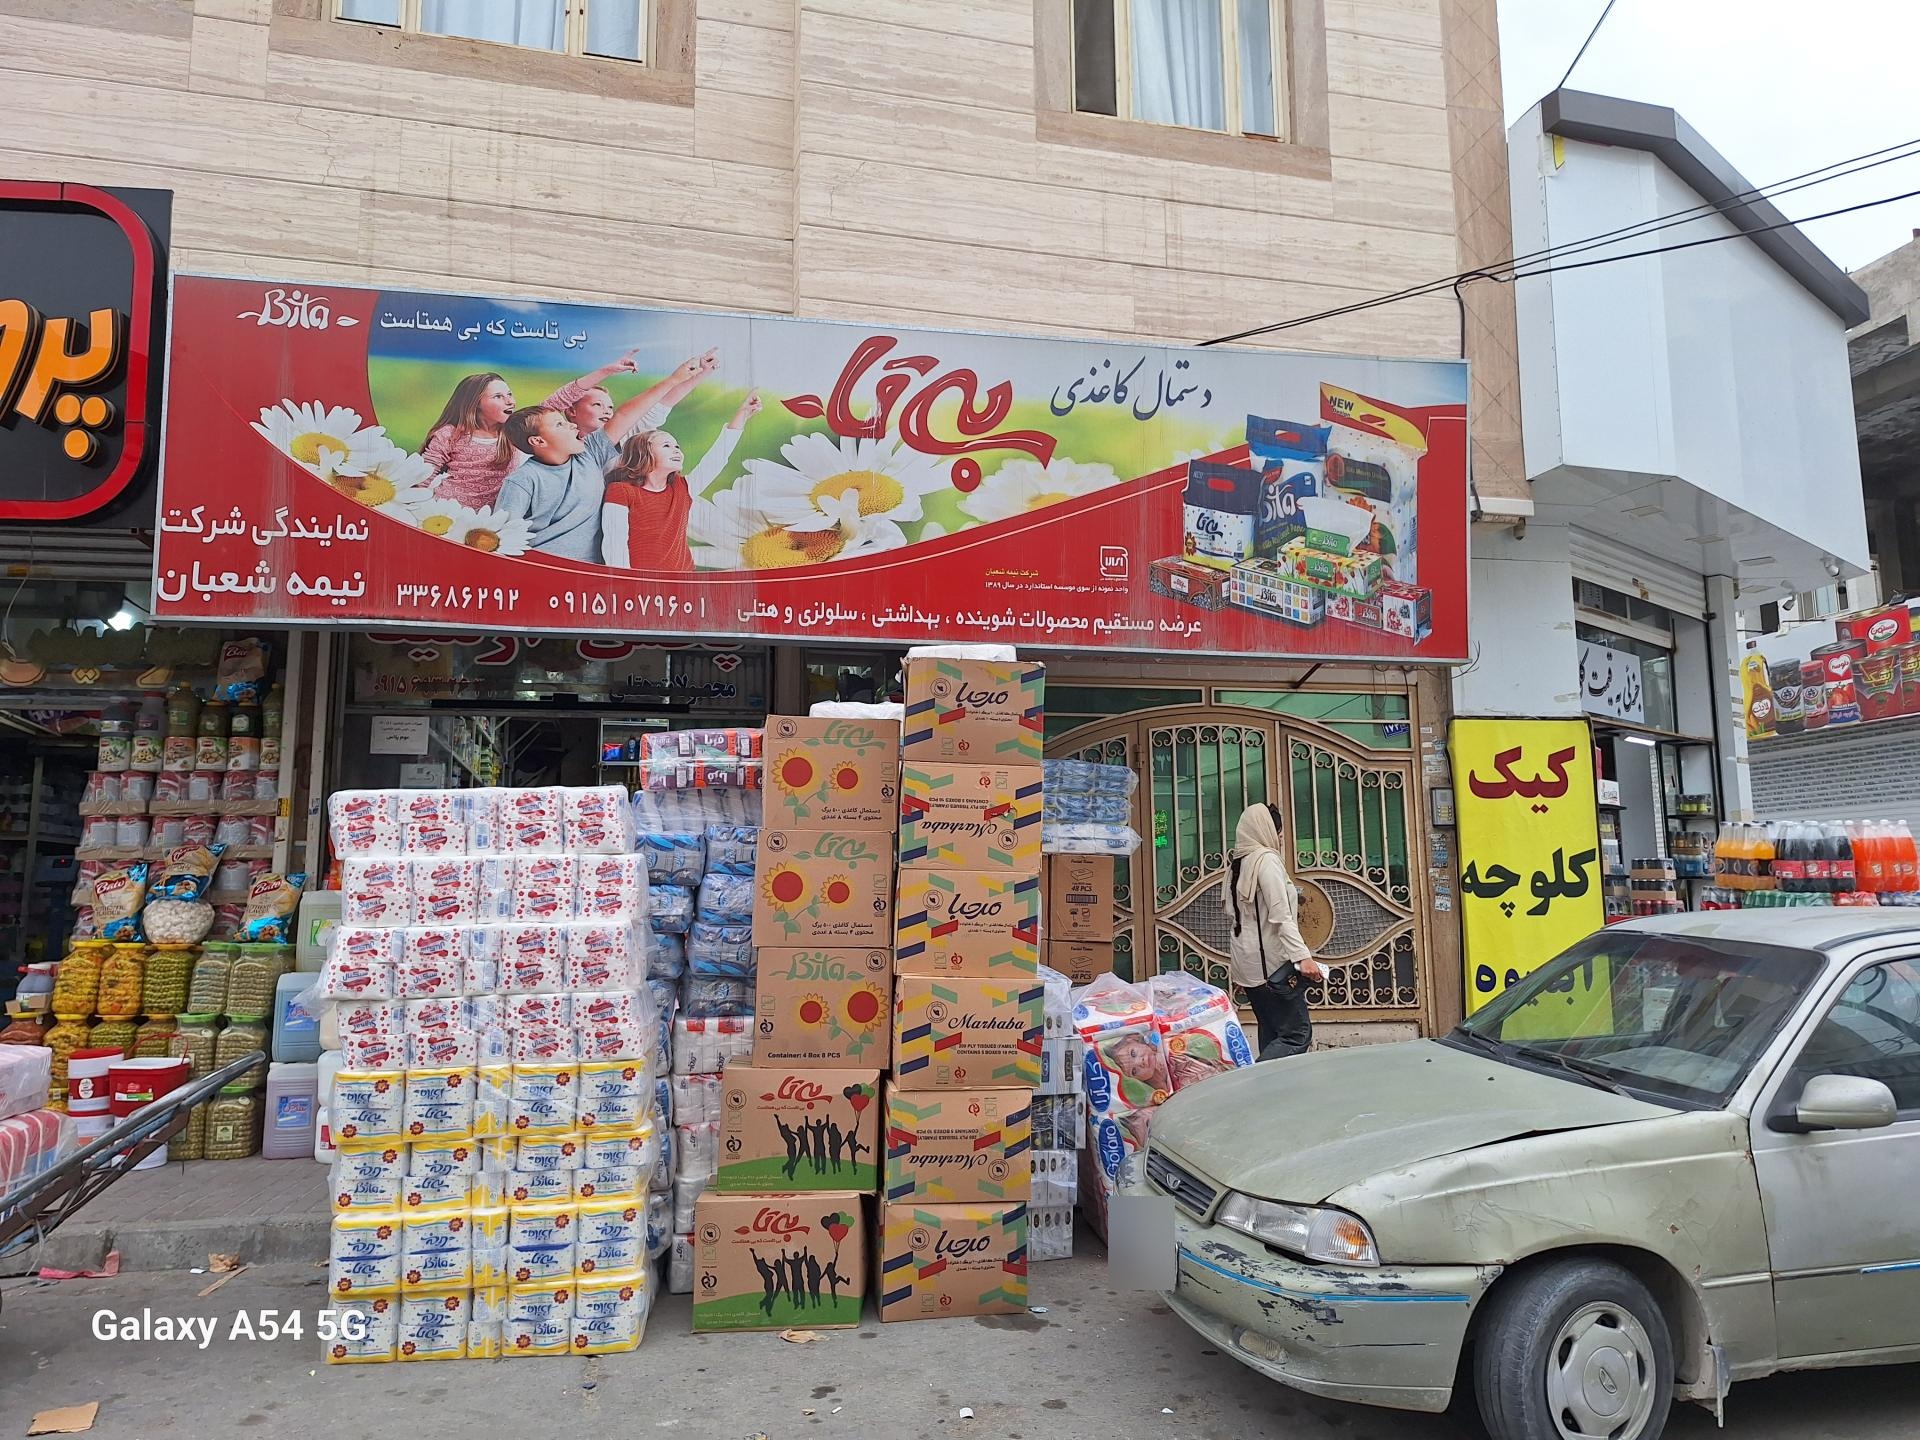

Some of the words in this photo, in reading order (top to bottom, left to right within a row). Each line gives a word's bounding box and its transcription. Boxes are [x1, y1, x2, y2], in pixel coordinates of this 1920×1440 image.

[255, 288, 331, 330] Bita
[379, 309, 453, 333] همتاست
[457, 320, 481, 341] بی
[485, 317, 506, 337] که
[510, 319, 560, 340] تاست
[563, 327, 588, 349] بی
[1050, 355, 1147, 417] کاغذی
[1132, 360, 1213, 422] دستمال
[1329, 394, 1354, 413] NEW
[160, 504, 247, 544] شرکت
[251, 505, 370, 547] نمایندگی
[156, 559, 278, 602] شعبان
[286, 571, 367, 607] نیمه
[396, 583, 520, 612] ۳۳۶۸۶۲۹۲
[549, 589, 706, 618] ۰۹۱۵۱۰۷۹۶۰۱
[737, 598, 779, 623] هتلی
[783, 607, 793, 625] و
[797, 602, 858, 628] سلولزی
[870, 603, 940, 631] بهداشتی
[955, 607, 1017, 630] شوینده
[1019, 609, 1090, 632] محصولات
[1093, 612, 1155, 635] مستقیم
[1159, 616, 1202, 635] عرضه
[955, 681, 1009, 708] مرحبا
[1468, 744, 1577, 814] کیک
[921, 820, 998, 838] Marhaba
[1460, 846, 1598, 919] کلوچه
[947, 892, 1003, 920] مرحبا
[786, 951, 846, 981] Bita
[1071, 973, 1079, 981] 48
[947, 1013, 1026, 1031] Marhaba
[907, 1153, 988, 1171] Marhaba
[934, 1230, 991, 1260] مرحبا
